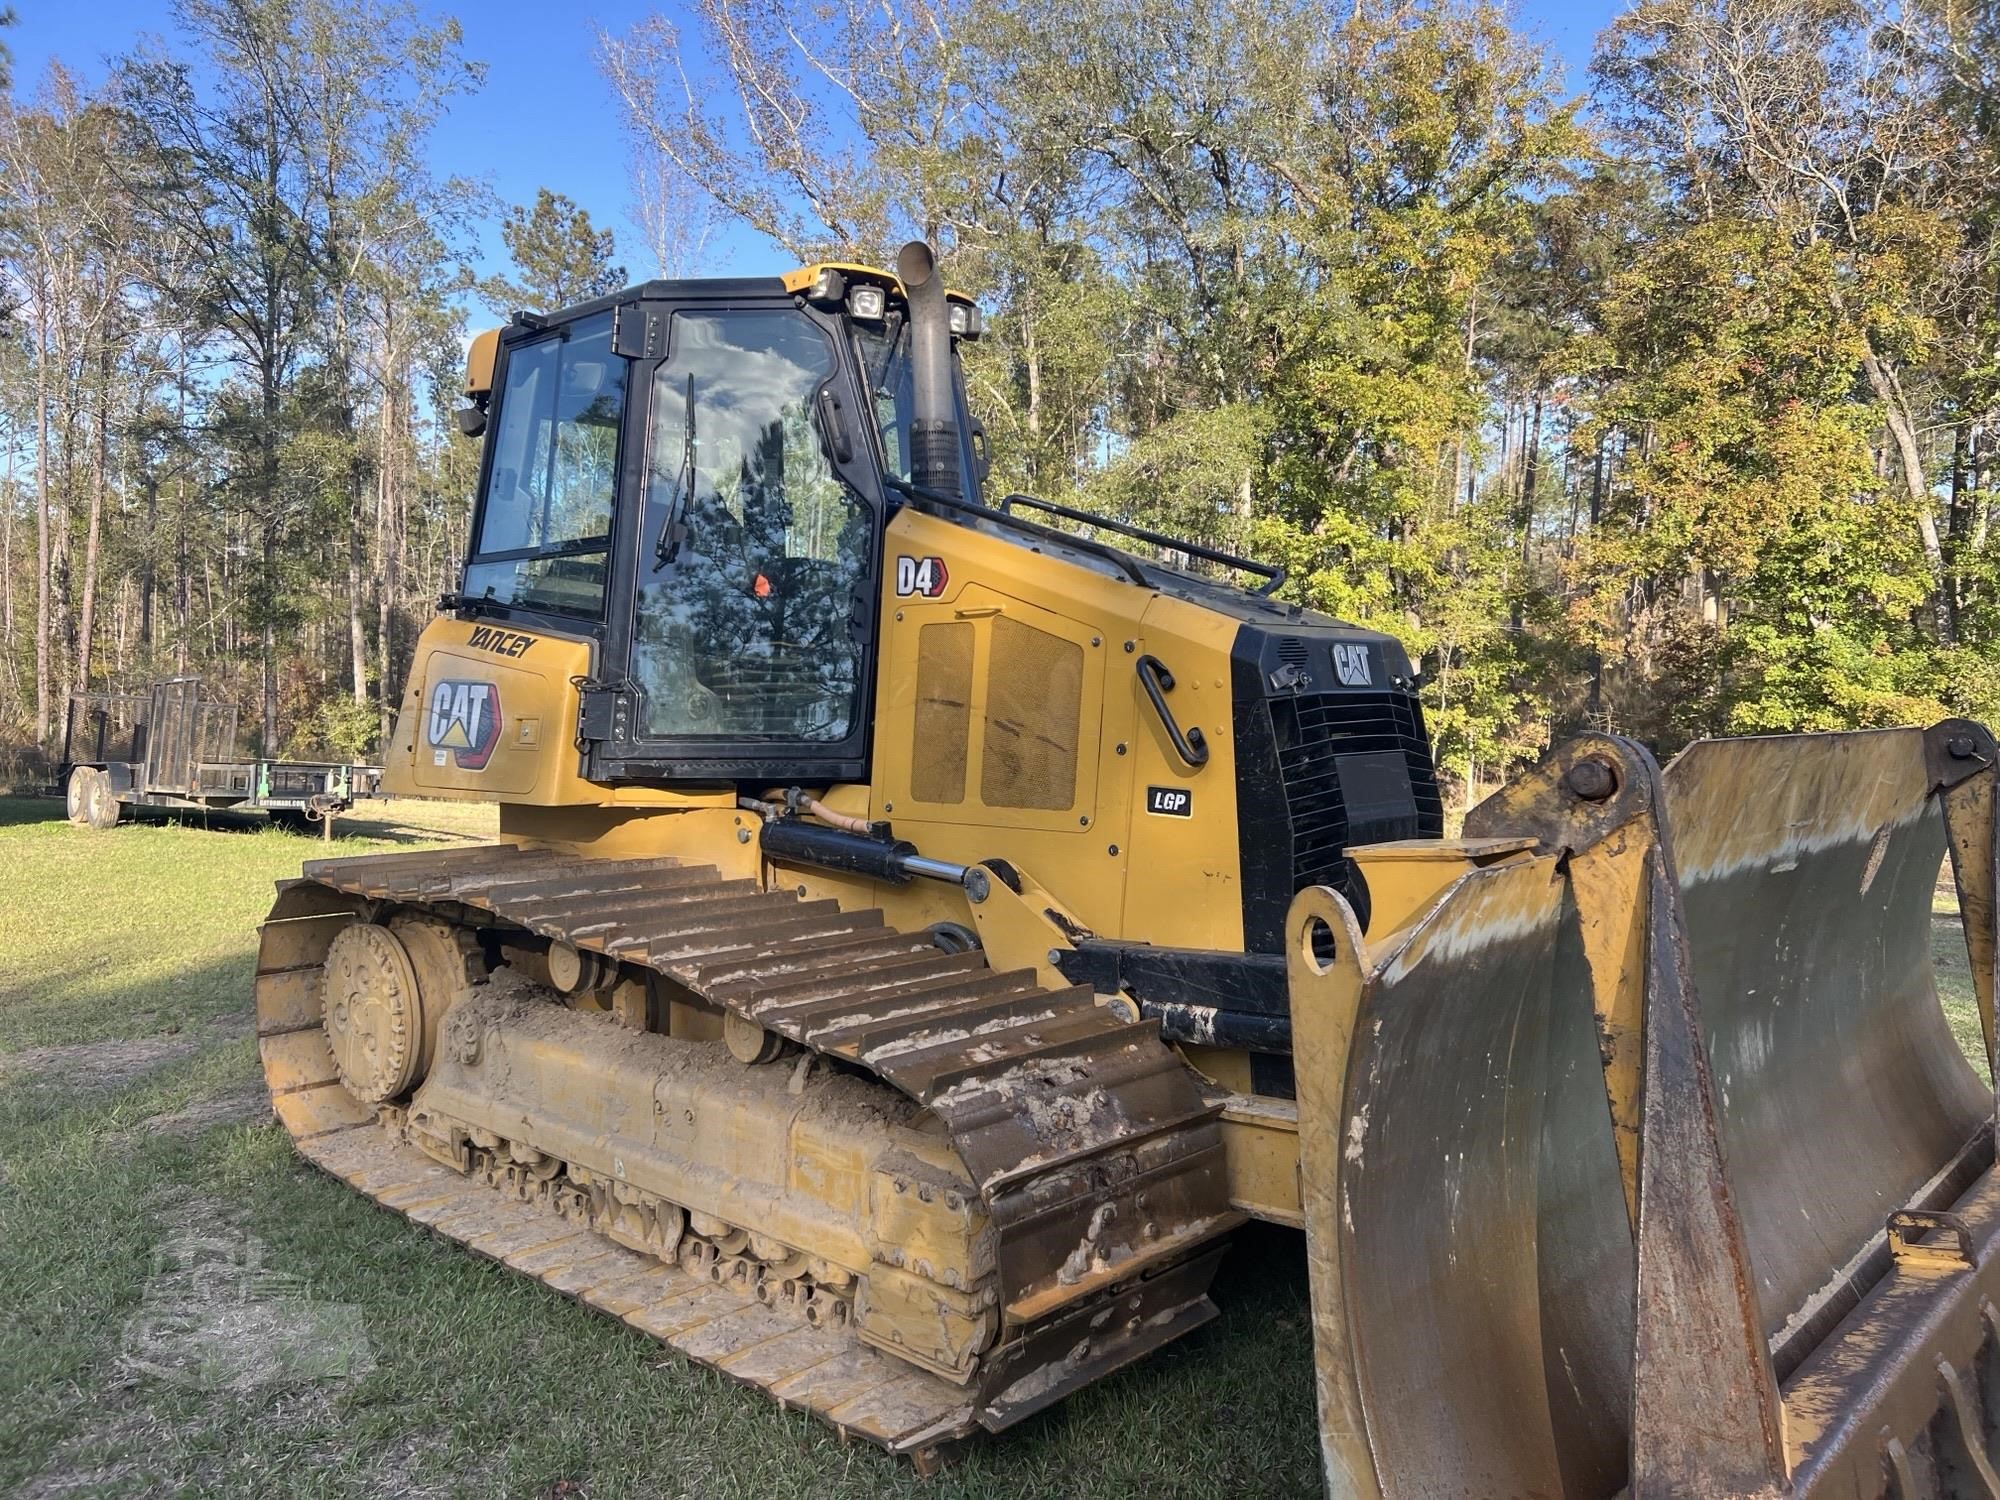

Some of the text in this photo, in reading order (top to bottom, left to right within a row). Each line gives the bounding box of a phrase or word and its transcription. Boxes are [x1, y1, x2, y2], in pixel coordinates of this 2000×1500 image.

[898, 557, 932, 595] D4
[467, 626, 537, 658] YANCEY
[1334, 645, 1372, 686] CAT
[430, 683, 488, 747] CAT
[1154, 792, 1186, 811] LGP
